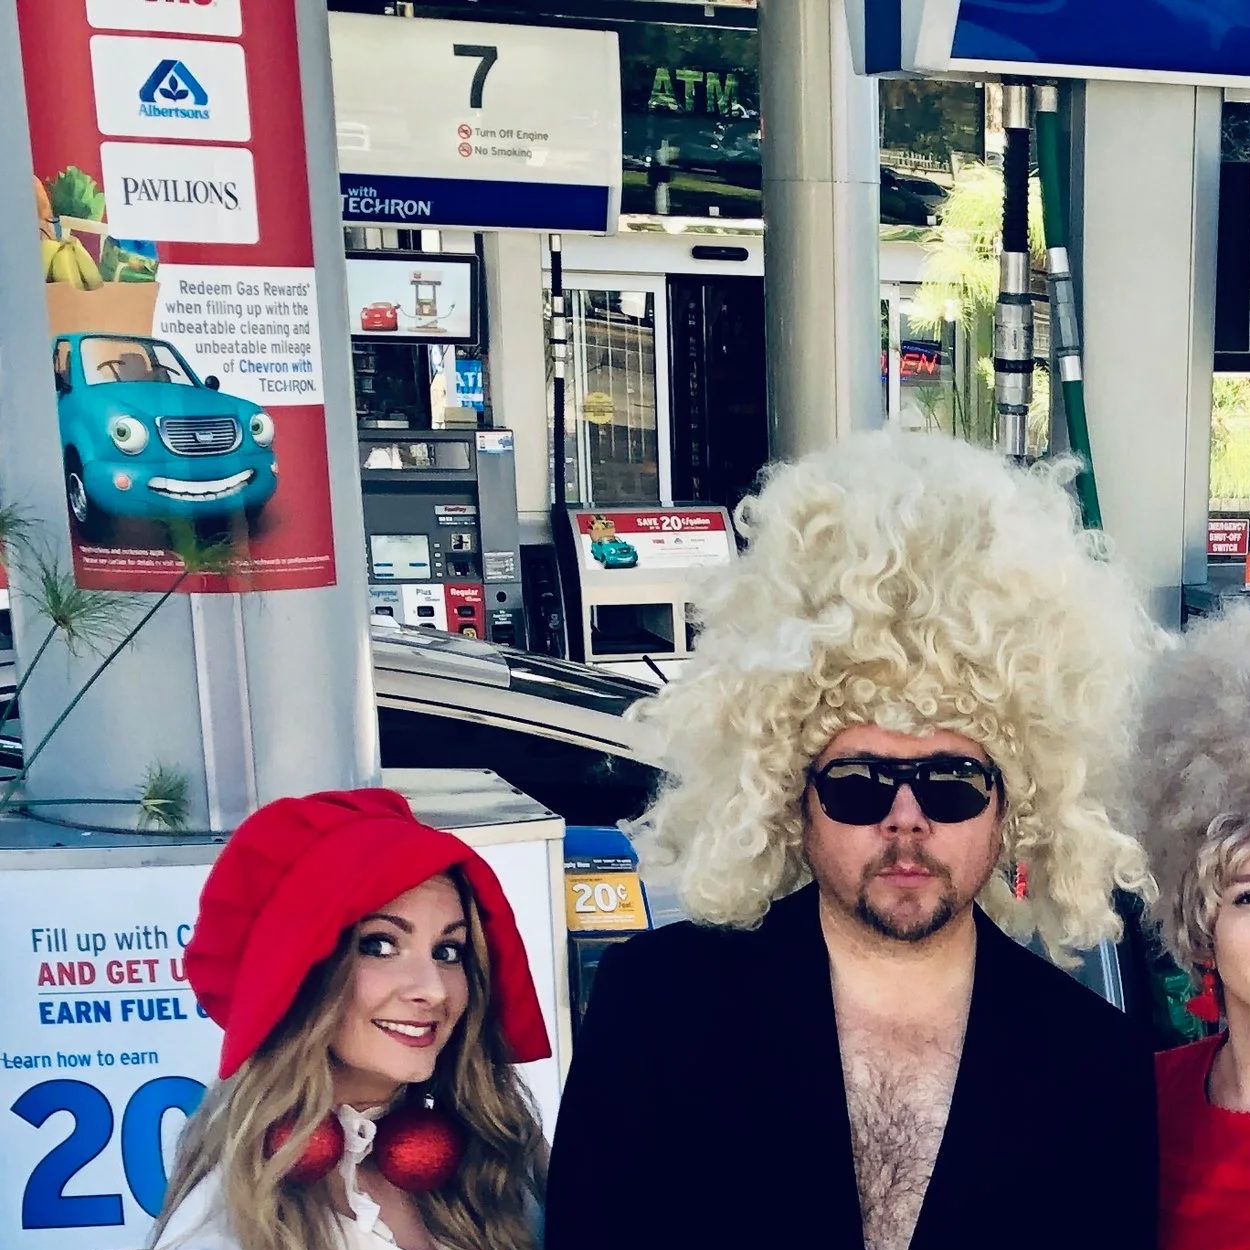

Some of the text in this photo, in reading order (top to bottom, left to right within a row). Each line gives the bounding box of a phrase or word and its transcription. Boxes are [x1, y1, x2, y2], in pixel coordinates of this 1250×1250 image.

[453, 44, 498, 109] 7
[648, 67, 740, 113] ATM
[139, 103, 210, 120] Albertsons
[475, 128, 549, 141] Turn Off Engine
[475, 146, 532, 159] No Smoking
[121, 176, 239, 211] PAVILIONS
[348, 186, 377, 198] with
[340, 194, 432, 219] TECHRON
[179, 280, 232, 295] Redeem
[236, 281, 260, 296] Gas
[166, 300, 309, 318] when filling up with the
[161, 320, 310, 337] unbeatable cleaning and
[195, 340, 311, 357] unbeatable mileage
[223, 359, 313, 373] of Chevron with
[1212, 543, 1238, 552] SWITCH
[416, 588, 432, 596] Plus
[450, 588, 479, 597] Regular
[31, 927, 67, 952] Fill
[77, 933, 106, 956] up
[114, 925, 168, 951] with
[37, 961, 96, 987] AND
[106, 958, 160, 985] GET
[39, 1000, 111, 1024] EARN
[121, 997, 187, 1022] FUEL
[3, 1050, 159, 1069] Learn how to earn
[10, 1075, 208, 1230] 20
